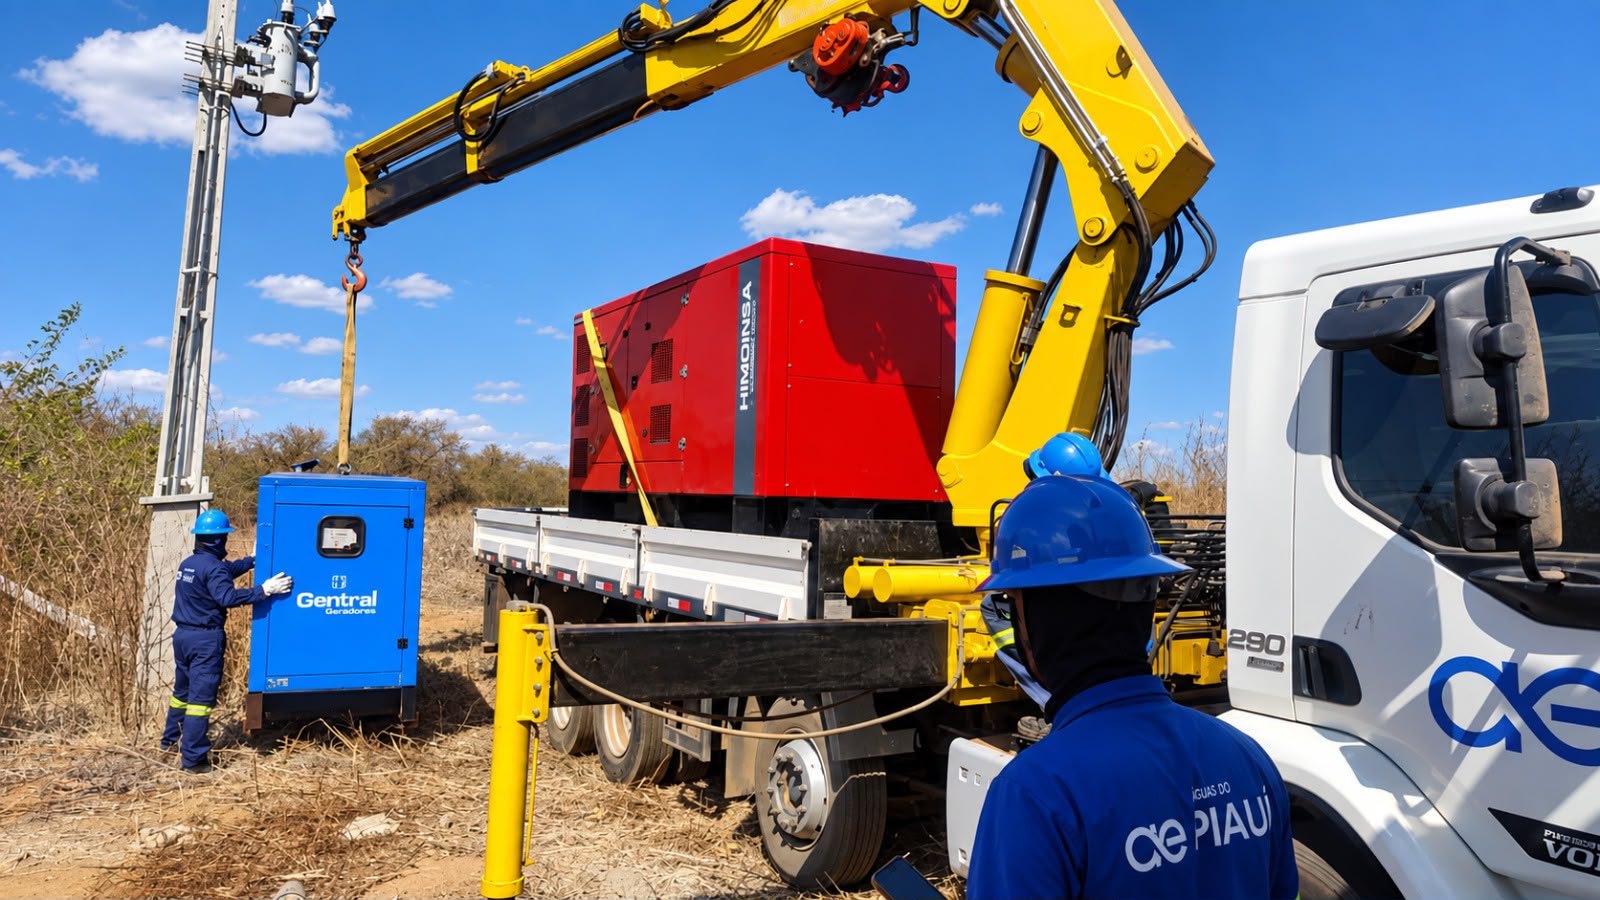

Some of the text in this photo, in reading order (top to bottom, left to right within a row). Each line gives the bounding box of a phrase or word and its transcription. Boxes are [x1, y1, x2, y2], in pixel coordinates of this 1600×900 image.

[740, 280, 752, 411] HIMOINSA
[296, 590, 378, 608] Gentral
[1228, 629, 1286, 657] 290
[1217, 781, 1231, 795] DO
[1194, 784, 1272, 851] PIAUÍ
